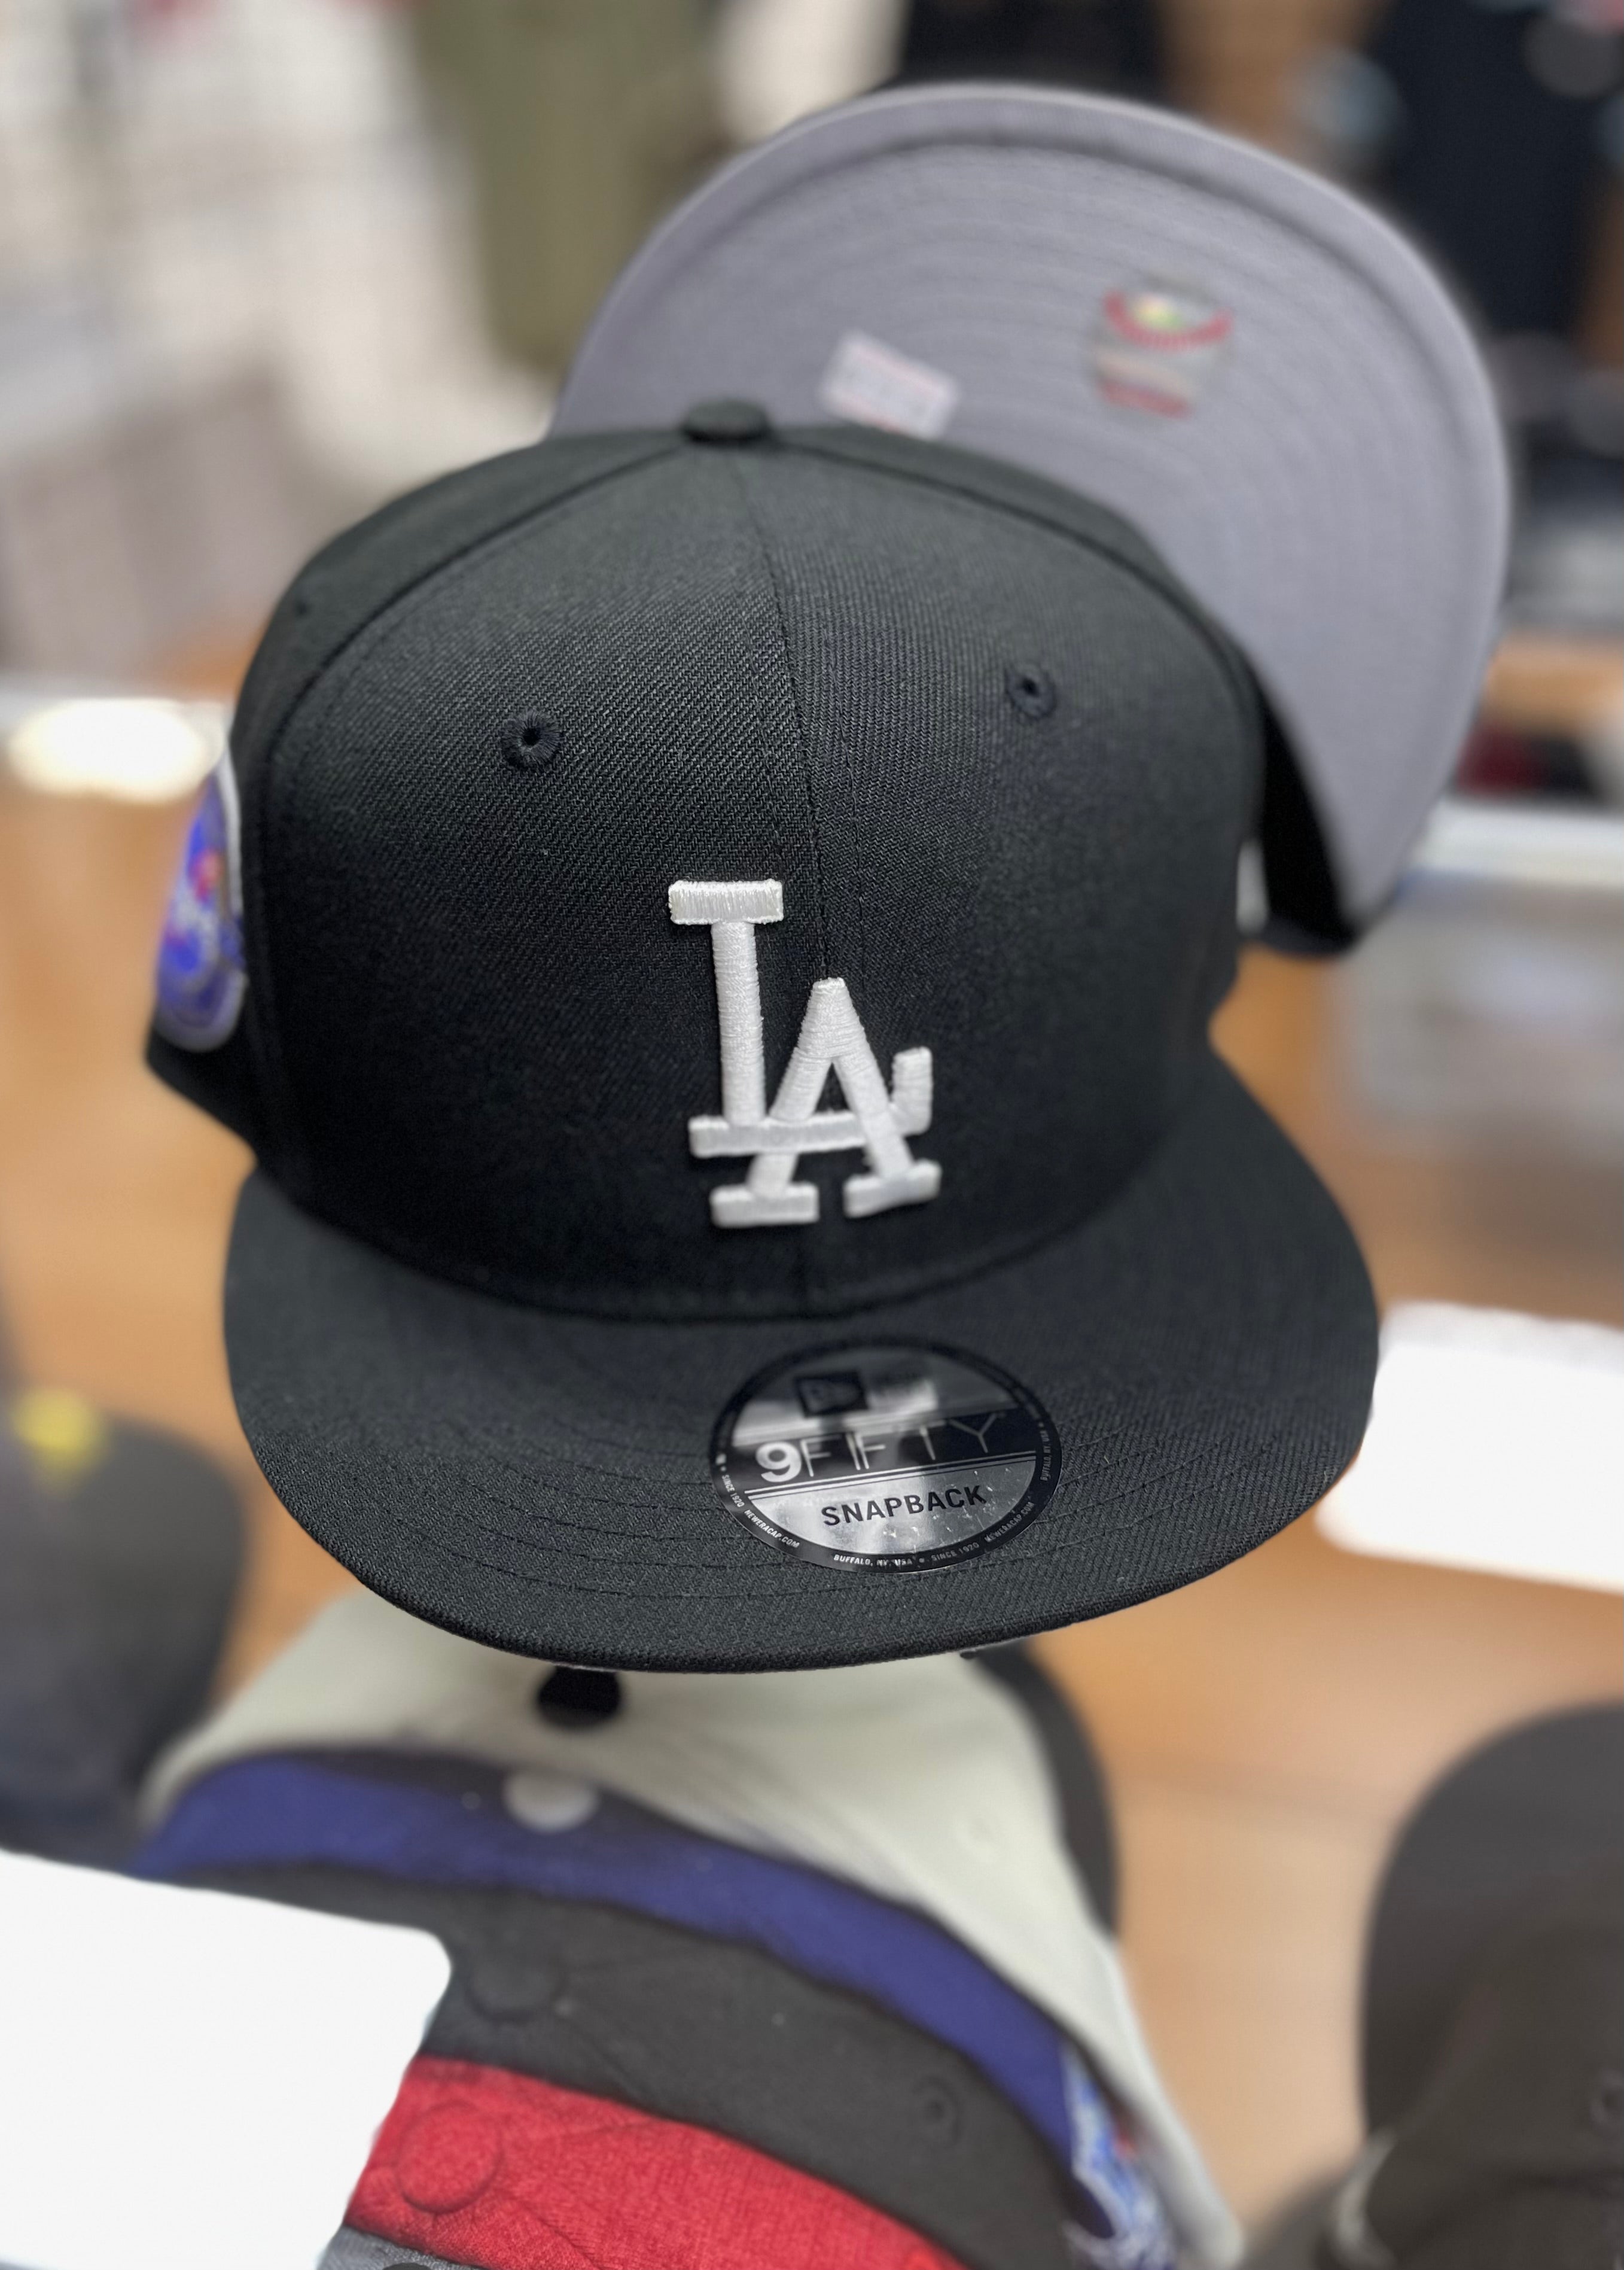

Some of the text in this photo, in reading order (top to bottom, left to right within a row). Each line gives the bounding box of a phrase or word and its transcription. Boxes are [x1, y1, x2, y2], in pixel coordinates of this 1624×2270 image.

[668, 878, 943, 1228] LA
[755, 1412, 1002, 1483] 9FIFTY
[721, 1474, 800, 1548] SINCE 1920 NEWERACAP.COM
[821, 1484, 987, 1526] SNAPBACK
[833, 1554, 873, 1566] BUFFALO,
[930, 1550, 958, 1562] SINCE
[958, 1542, 980, 1554] 1920
